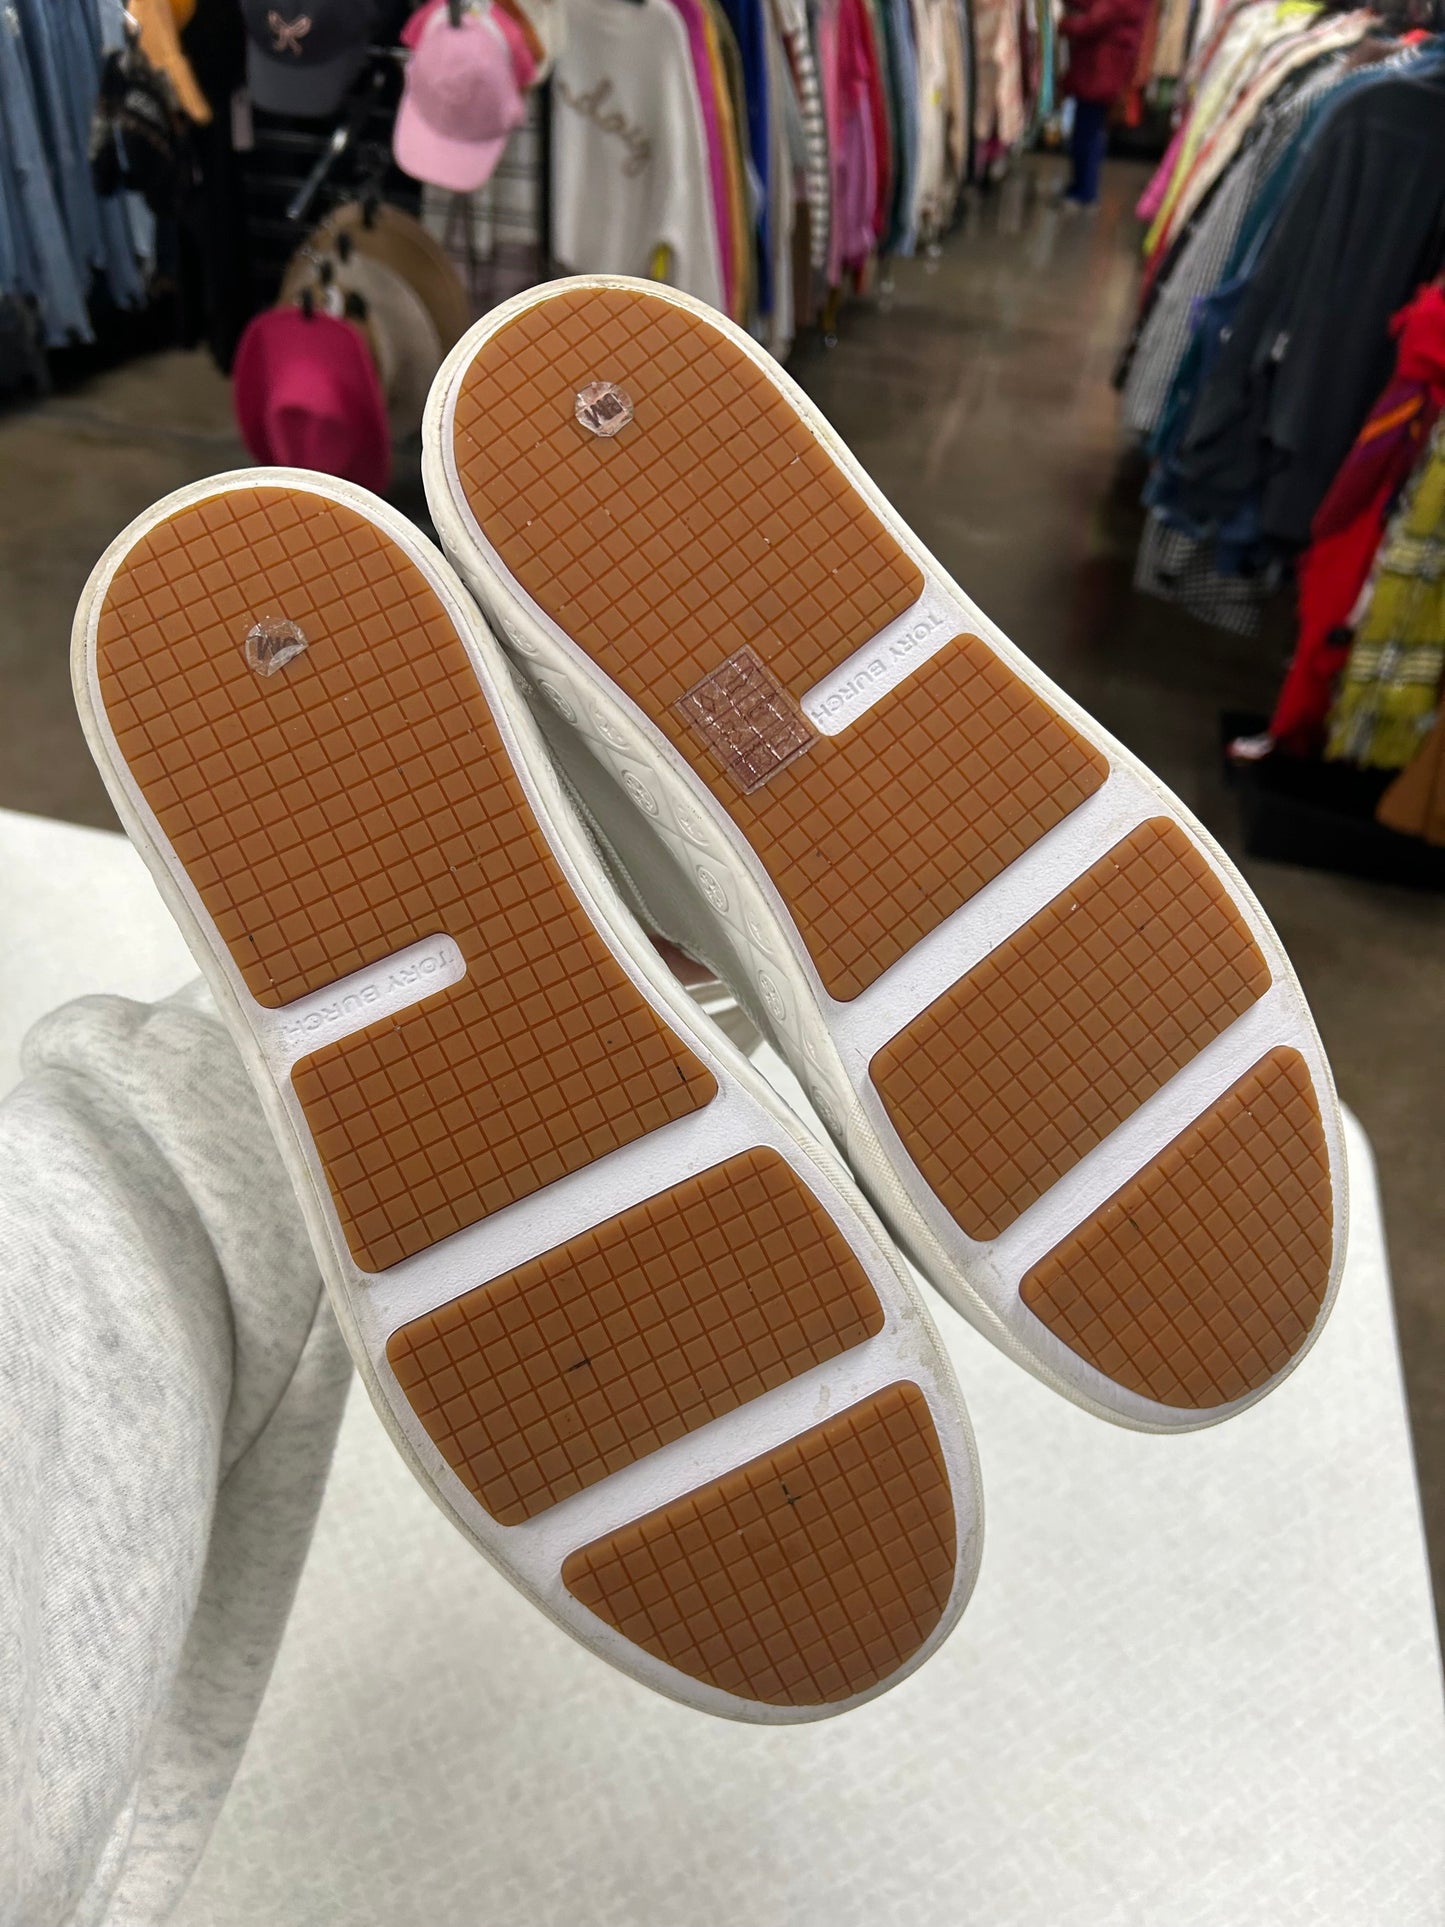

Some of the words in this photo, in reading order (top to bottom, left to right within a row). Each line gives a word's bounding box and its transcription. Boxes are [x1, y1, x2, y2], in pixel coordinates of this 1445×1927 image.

[890, 613, 945, 663] TORY
[811, 659, 887, 724] BURCH
[384, 950, 454, 993] TORY
[282, 984, 380, 1041] BURCH
